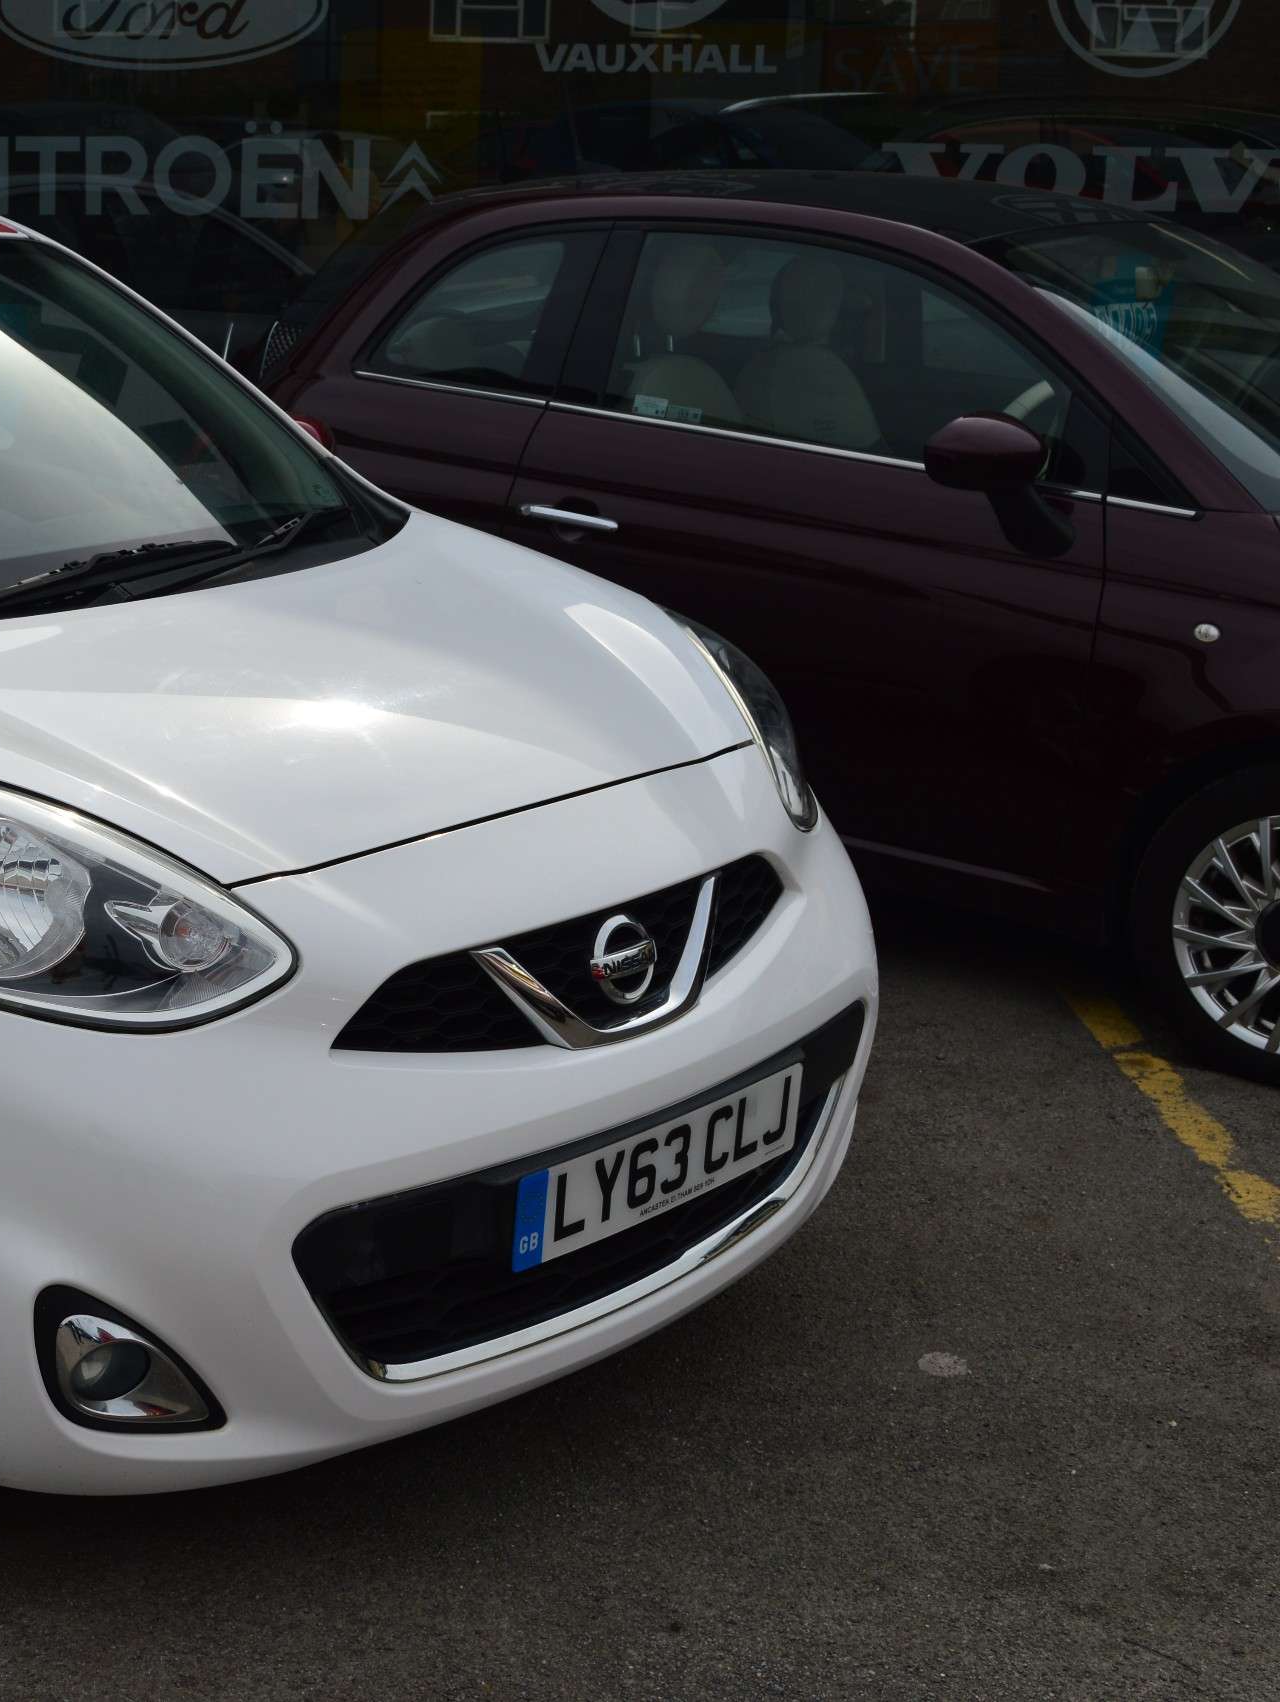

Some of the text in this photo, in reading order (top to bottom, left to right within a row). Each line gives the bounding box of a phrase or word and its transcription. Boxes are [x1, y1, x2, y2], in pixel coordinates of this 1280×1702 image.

[535, 42, 778, 74] VAUXHALL
[553, 1075, 792, 1243] LY63 CLJ
[519, 1231, 540, 1254] GB
